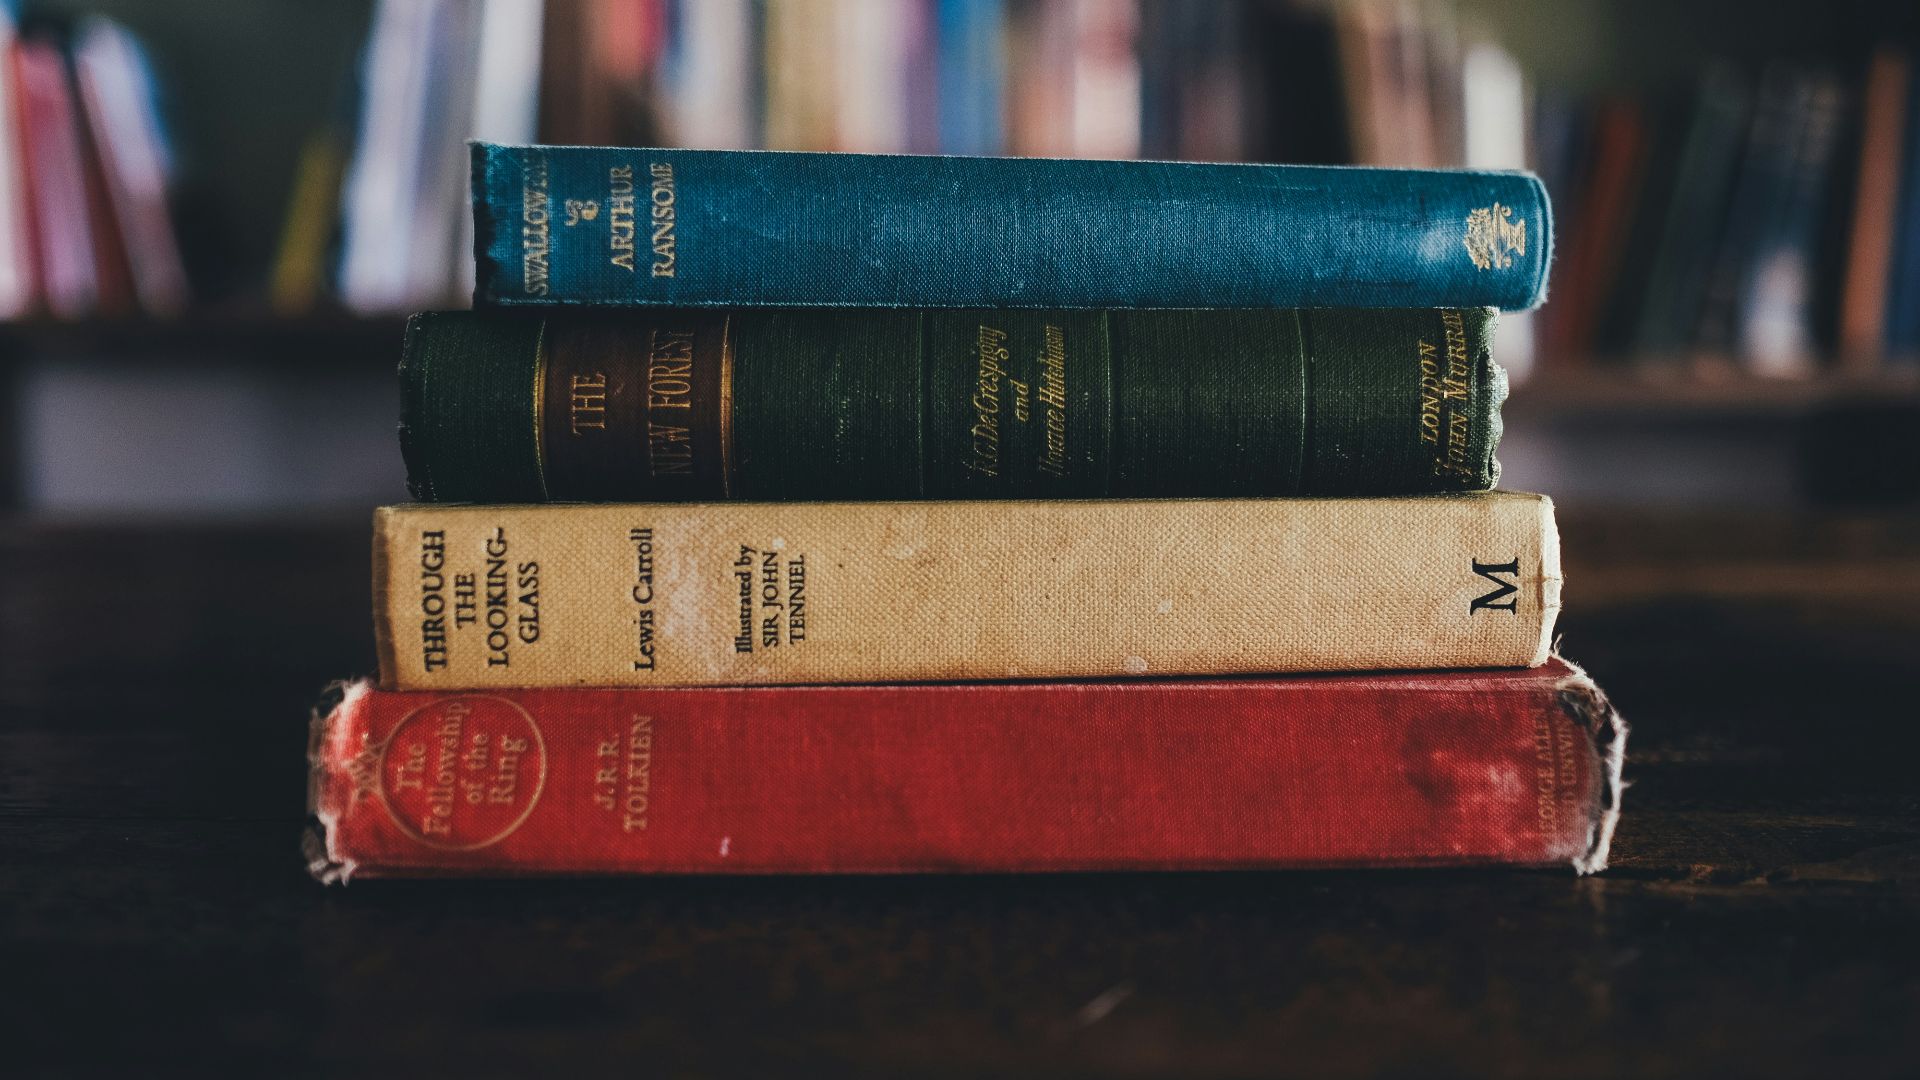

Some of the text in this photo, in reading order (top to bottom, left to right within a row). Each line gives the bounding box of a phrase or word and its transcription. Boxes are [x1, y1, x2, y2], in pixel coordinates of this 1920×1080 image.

[610, 164, 635, 272] ARTHUR
[651, 162, 676, 278] RANSOME
[571, 371, 606, 436] THE
[647, 328, 693, 478] NEW FOREST
[1009, 379, 1030, 422] and
[1418, 339, 1440, 446] LONDON
[1038, 409, 1065, 478] Horace
[1434, 408, 1472, 484] JOHN
[422, 529, 447, 672] THROUGH
[454, 573, 476, 629] THE
[485, 527, 509, 667] LOOKING-
[518, 561, 540, 644] GLASS
[630, 528, 655, 672] Lewis Carroll
[733, 545, 756, 654] Illustrated by
[762, 550, 784, 648] SIR JOHN
[789, 554, 806, 645] TENNIEL
[1471, 556, 1520, 617] M
[394, 743, 427, 793] The
[422, 702, 473, 835] Fellowship
[459, 733, 489, 805] of the
[488, 735, 529, 805] Ring
[622, 712, 654, 834] TOLKIEN
